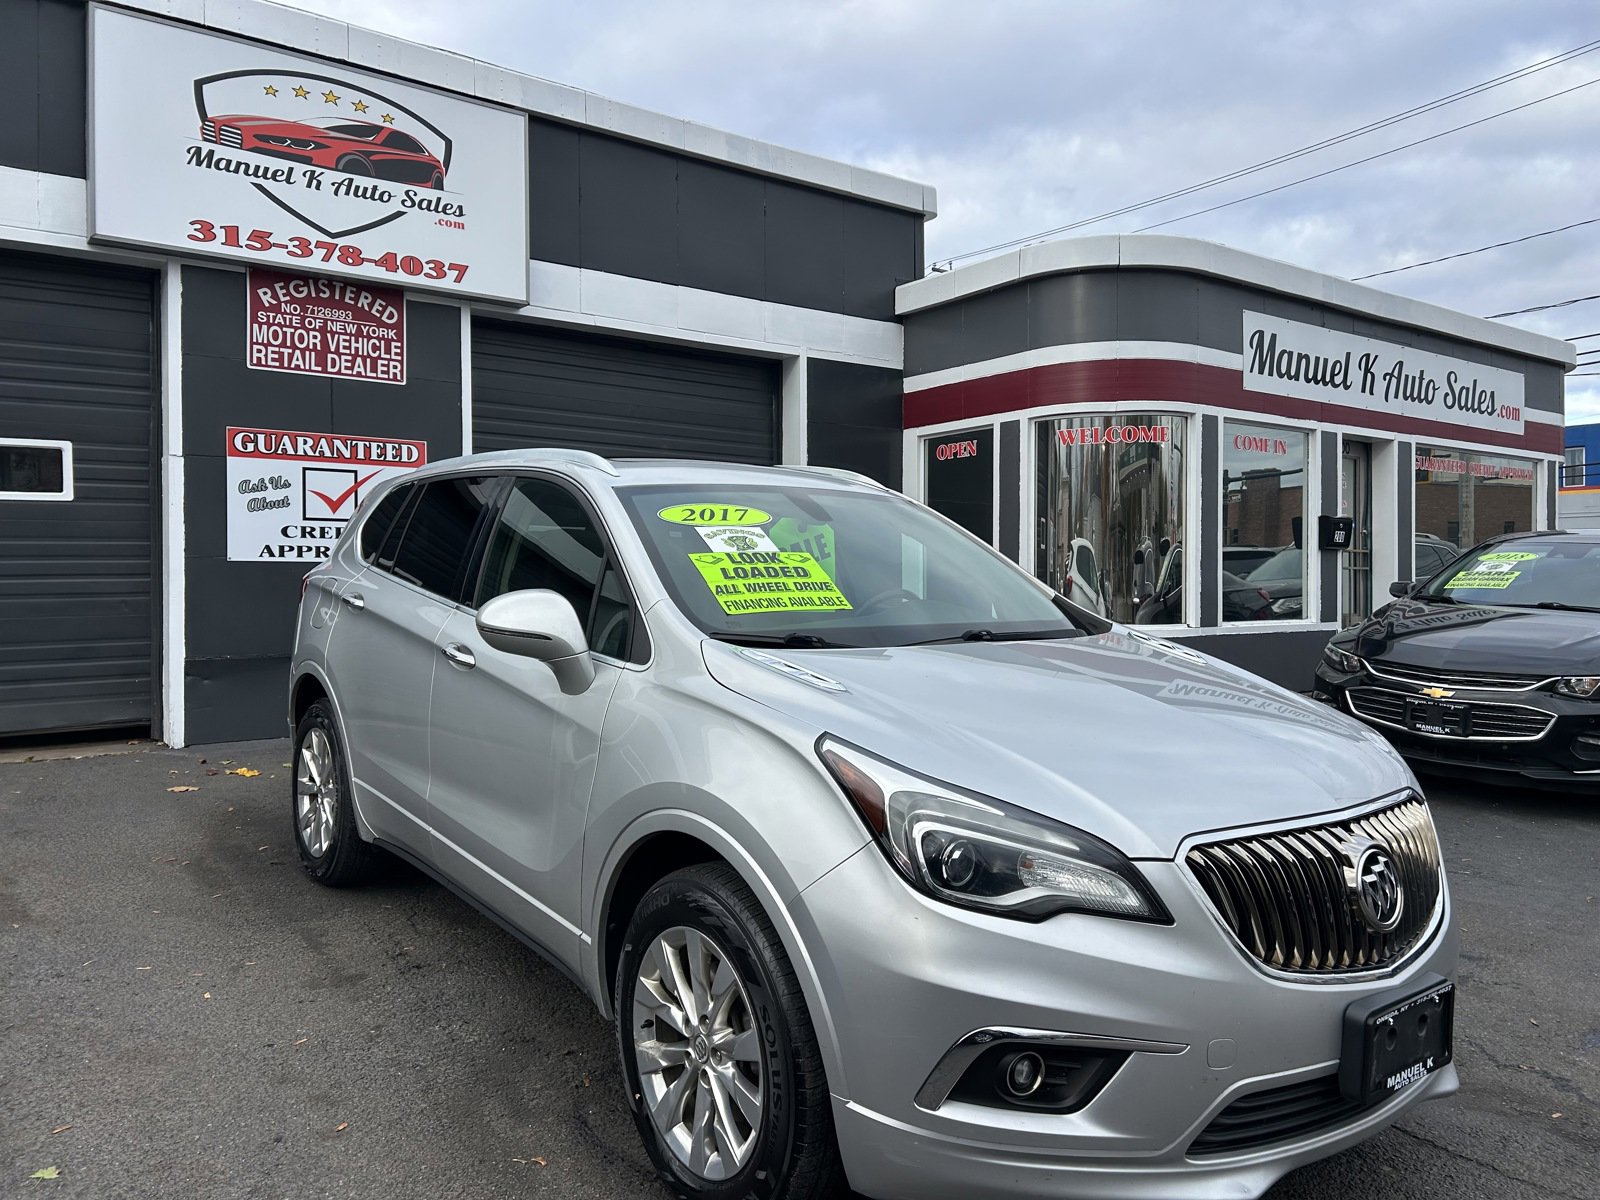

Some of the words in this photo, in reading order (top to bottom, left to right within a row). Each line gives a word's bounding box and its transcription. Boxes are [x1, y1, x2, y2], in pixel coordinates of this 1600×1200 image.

[186, 145, 297, 185] Manuel
[302, 168, 323, 191] K
[330, 176, 397, 204] Auto
[400, 189, 466, 218] Sales
[434, 217, 465, 230] .com
[187, 219, 469, 284] 315-378-4037
[257, 279, 399, 325] REGISTERED
[281, 303, 304, 316] NO.
[306, 305, 353, 320] 7126993
[257, 311, 301, 327] STATE
[305, 317, 324, 330] OF
[327, 321, 358, 335] NEW
[361, 325, 397, 340] YORK
[252, 323, 321, 350] MOTOR
[326, 332, 401, 360] VEHICLE
[252, 345, 322, 372] RETAIL
[327, 353, 401, 380] DEALER
[1249, 329, 1352, 391] Manuel
[1358, 352, 1379, 396] K
[1382, 360, 1440, 406] Auto
[1057, 425, 1170, 446] WELCOME
[1233, 434, 1271, 454] COME
[1273, 438, 1287, 456] IN
[232, 431, 420, 463] GUARANTEED
[936, 440, 977, 461] OPEN
[238, 478, 268, 495] Ask
[268, 475, 291, 491] Us
[247, 496, 290, 512] About
[681, 508, 749, 522] 2017
[281, 525, 343, 540] CRE
[258, 544, 331, 559] APPR
[725, 552, 784, 565] LOOK
[720, 566, 811, 580] LOADED
[715, 583, 744, 596] ALL
[744, 582, 791, 594] WHEEL
[795, 581, 835, 593] DRIVE
[724, 597, 787, 612] FINANCING
[790, 595, 848, 607] AVAILABLE
[1387, 1062, 1425, 1089] MANUEL
[1427, 1057, 1434, 1068] K
[1394, 1079, 1409, 1091] AUTO
[1410, 1069, 1428, 1083] SALES
